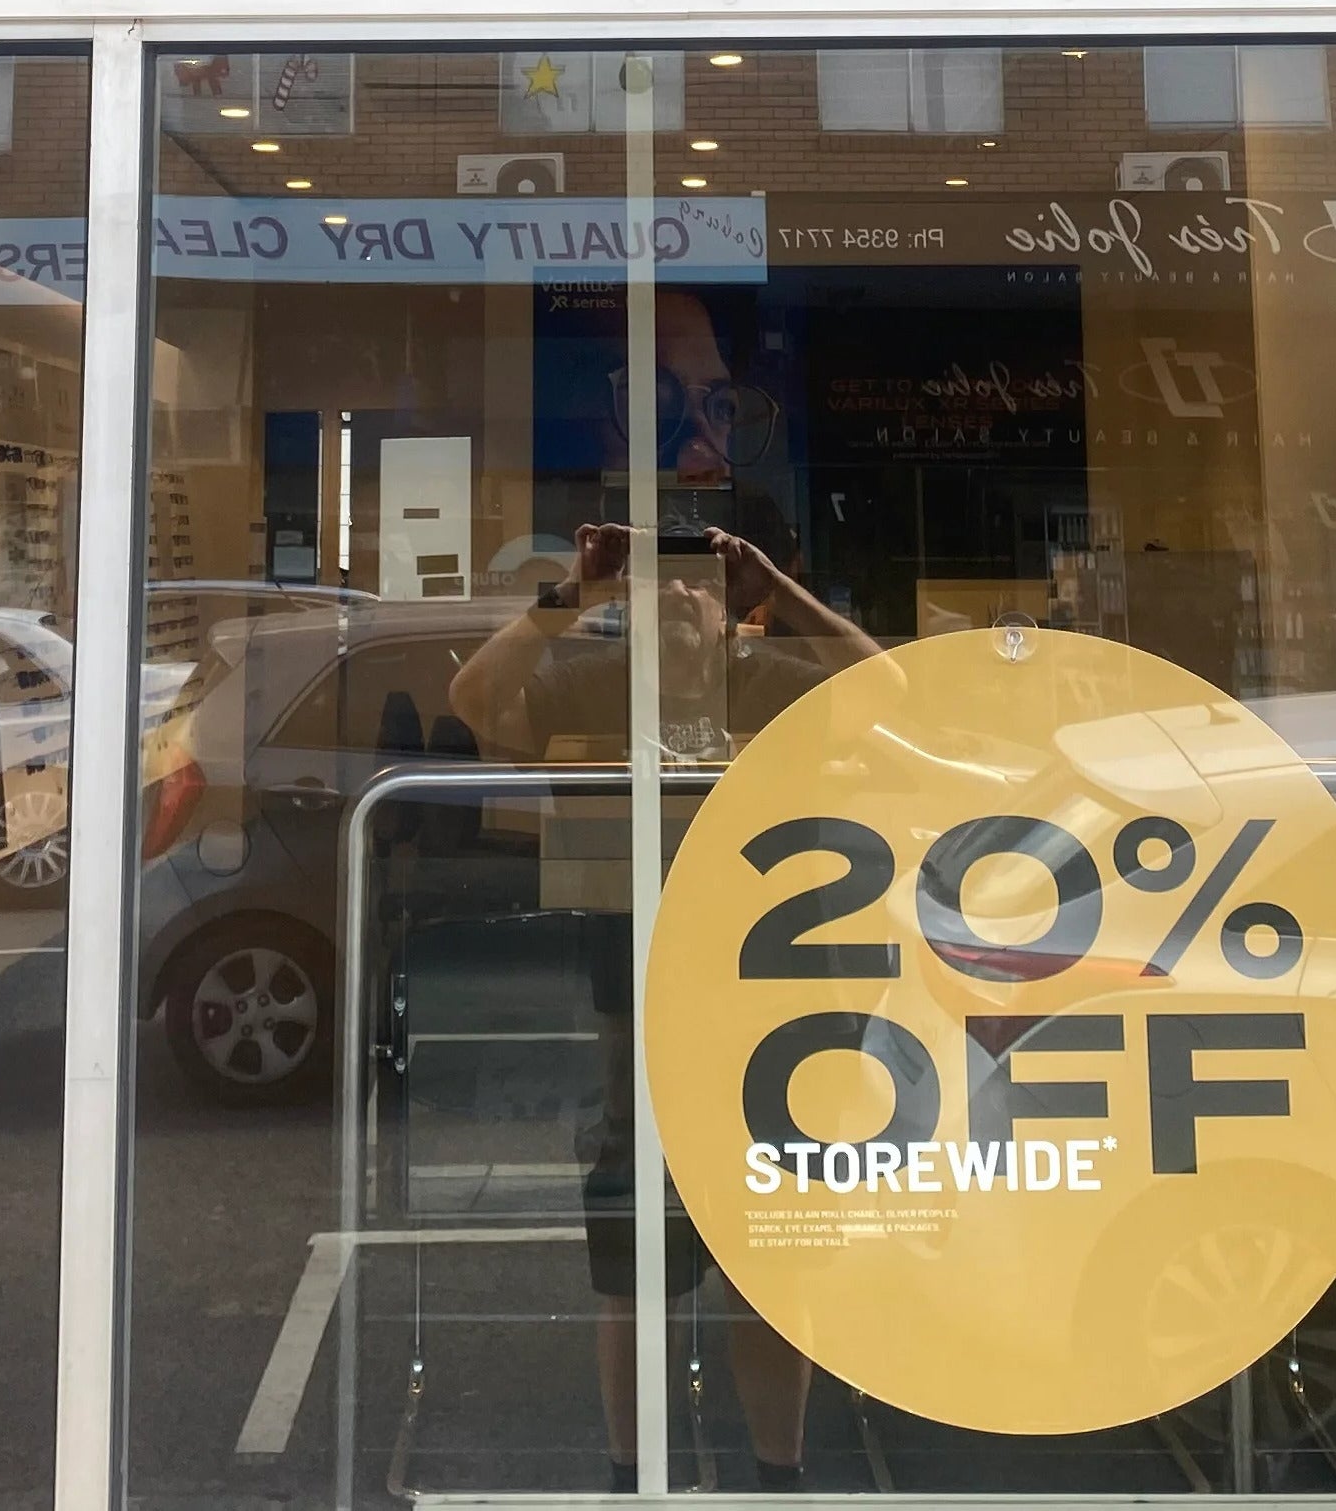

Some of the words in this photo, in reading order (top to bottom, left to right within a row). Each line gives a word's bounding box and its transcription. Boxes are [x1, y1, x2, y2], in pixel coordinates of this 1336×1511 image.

[737, 814, 1305, 984] 20%
[740, 1010, 1308, 1183] OFF
[748, 1238, 766, 1247] SEE
[767, 1238, 793, 1247] STAFF
[794, 1238, 812, 1247] FOR
[785, 1224, 801, 1233] EYE
